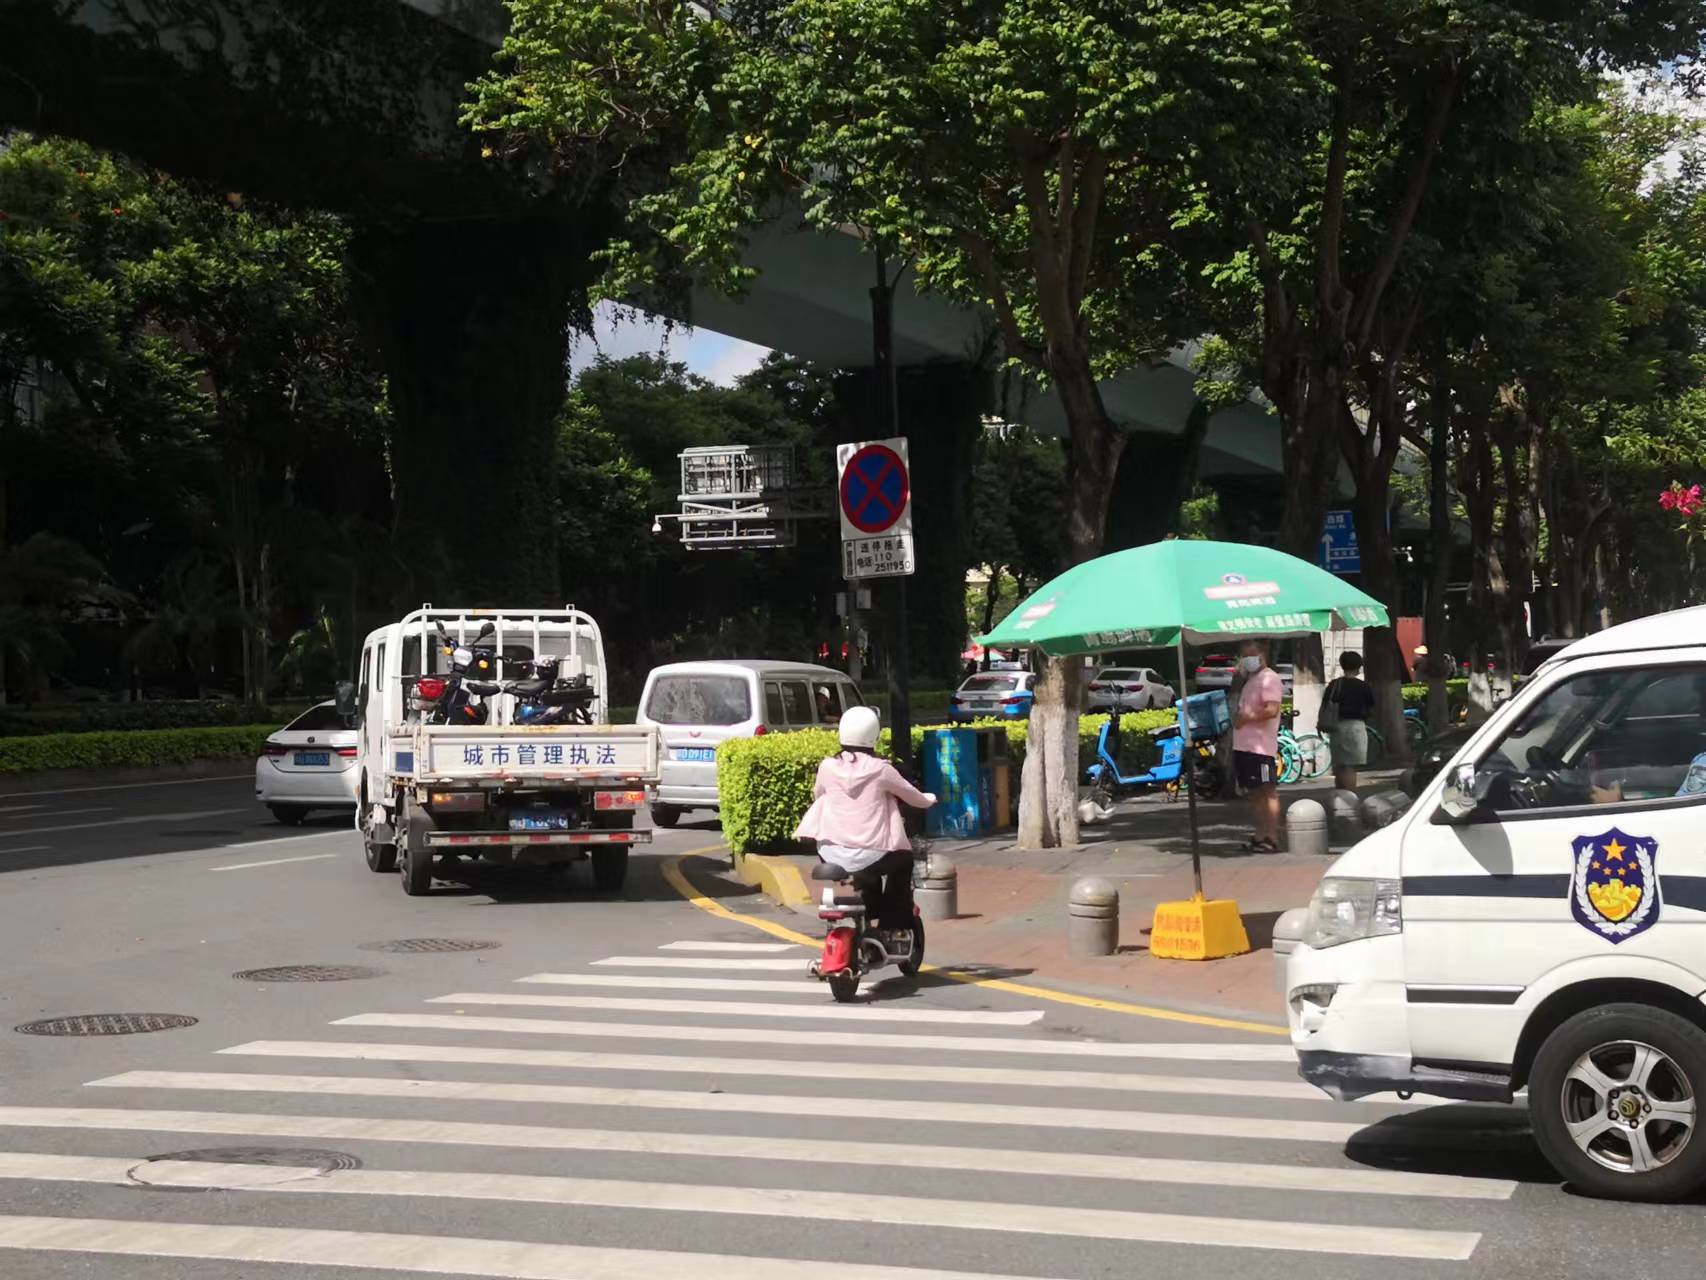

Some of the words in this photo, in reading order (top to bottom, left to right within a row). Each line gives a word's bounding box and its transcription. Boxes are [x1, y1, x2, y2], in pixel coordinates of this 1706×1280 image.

[463, 744, 616, 766] 城市管理执法
